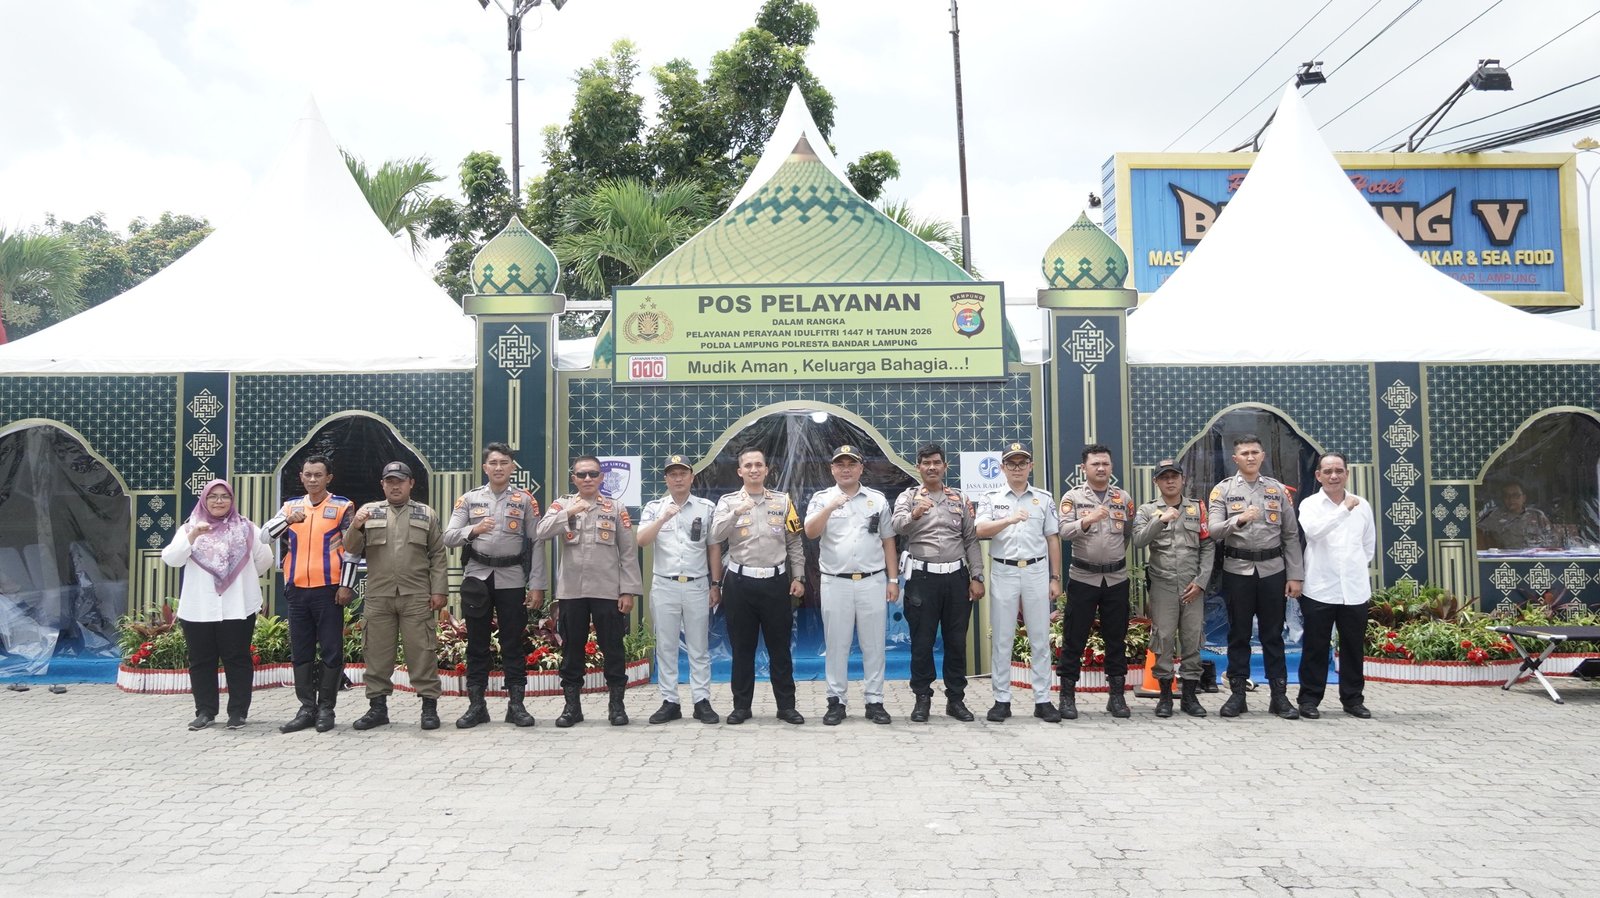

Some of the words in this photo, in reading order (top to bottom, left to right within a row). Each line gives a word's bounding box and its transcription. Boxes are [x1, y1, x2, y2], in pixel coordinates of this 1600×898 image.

[1476, 203, 1524, 241] V
[1482, 250, 1511, 266] SEA
[1515, 249, 1555, 265] FOOD
[1480, 272, 1537, 284] LAMPUNG
[698, 296, 752, 314] POS
[761, 293, 921, 313] PELAYANAN
[806, 318, 846, 326] RANGKA
[742, 329, 791, 338] PERAYAAN
[794, 329, 839, 337] IDULFITRI
[842, 328, 863, 336] 1447
[866, 328, 873, 336] H
[876, 328, 907, 336] TAHUN
[910, 328, 932, 336] 2026
[781, 340, 829, 348] POLRESTA
[832, 340, 870, 348] BANDAR
[872, 339, 918, 347] LAMPUNG
[633, 363, 663, 376] 110
[688, 360, 736, 374] Mudik
[741, 360, 788, 374] Aman
[802, 358, 876, 376] Keluarga
[506, 502, 525, 510] POLRI
